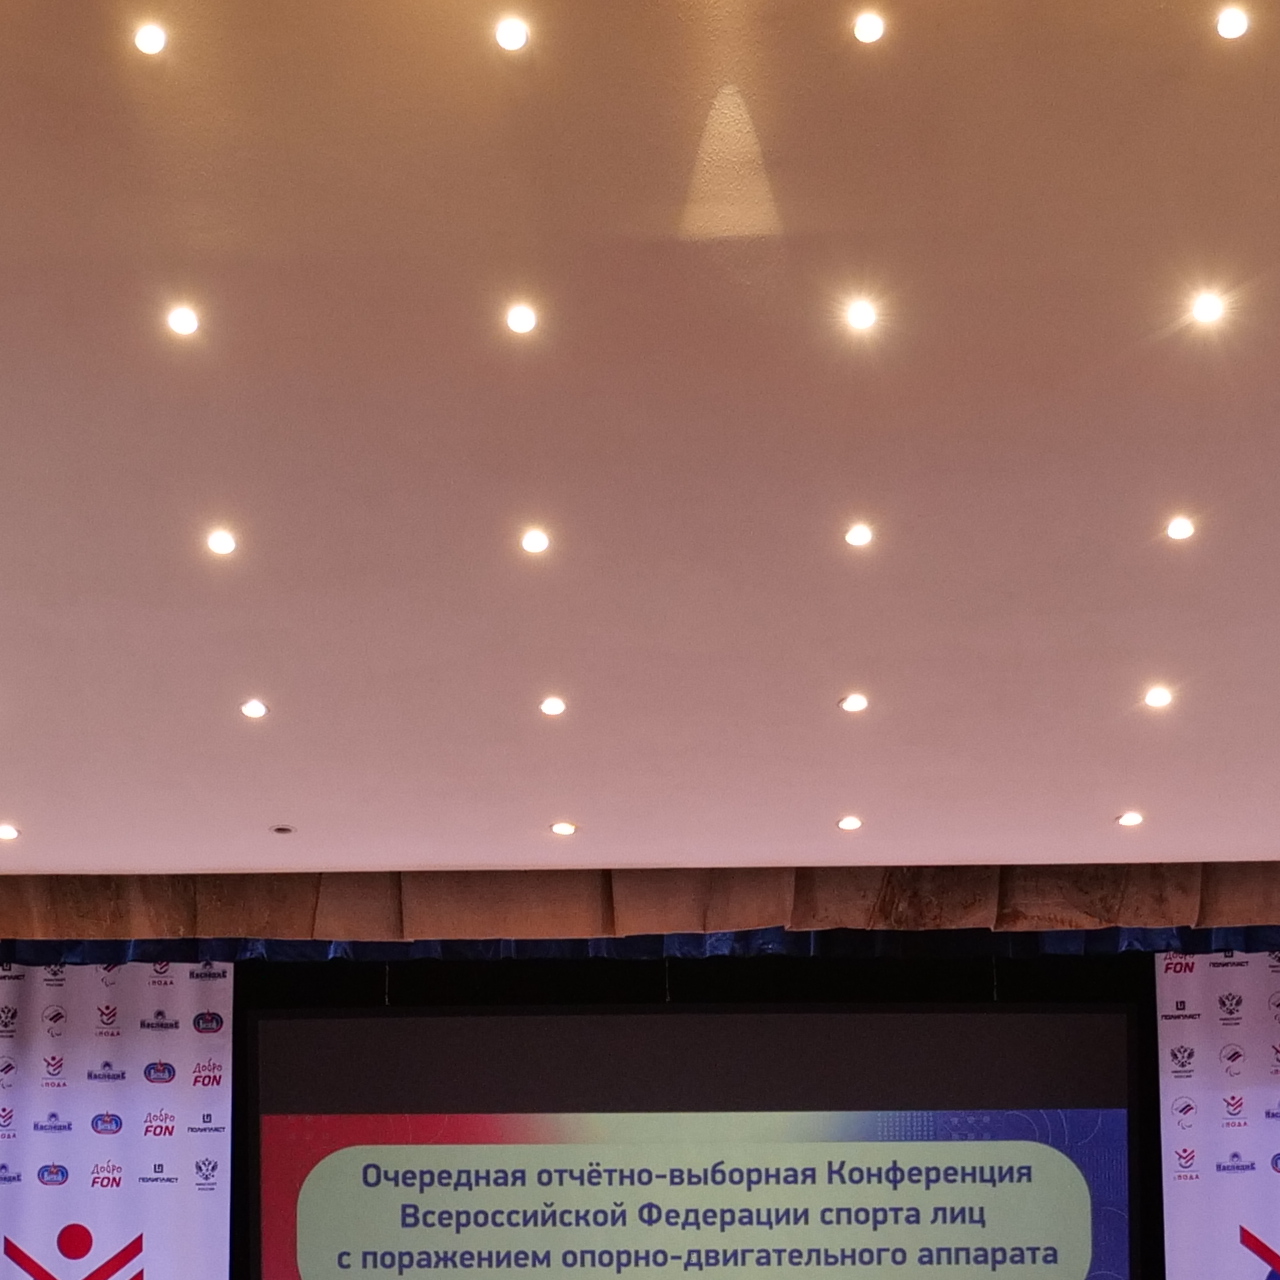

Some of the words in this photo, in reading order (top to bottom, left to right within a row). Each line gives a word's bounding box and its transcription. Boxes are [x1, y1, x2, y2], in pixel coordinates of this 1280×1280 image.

[1164, 962, 1195, 973] FON
[193, 1075, 222, 1086] FON
[144, 1125, 174, 1136] FON
[91, 1176, 121, 1188] FON
[361, 1163, 527, 1194] Очередная
[536, 1160, 817, 1192] отчётно-выборная
[826, 1160, 1033, 1191] Конференция
[400, 1202, 627, 1234] Всероссийской
[637, 1202, 810, 1233] Федерации
[820, 1206, 921, 1231] спорта
[930, 1206, 986, 1228] лиц
[336, 1250, 352, 1270] с
[361, 1248, 552, 1275] поражением
[561, 1246, 908, 1274] опорно-двигательного
[916, 1246, 1059, 1272] аппарата
